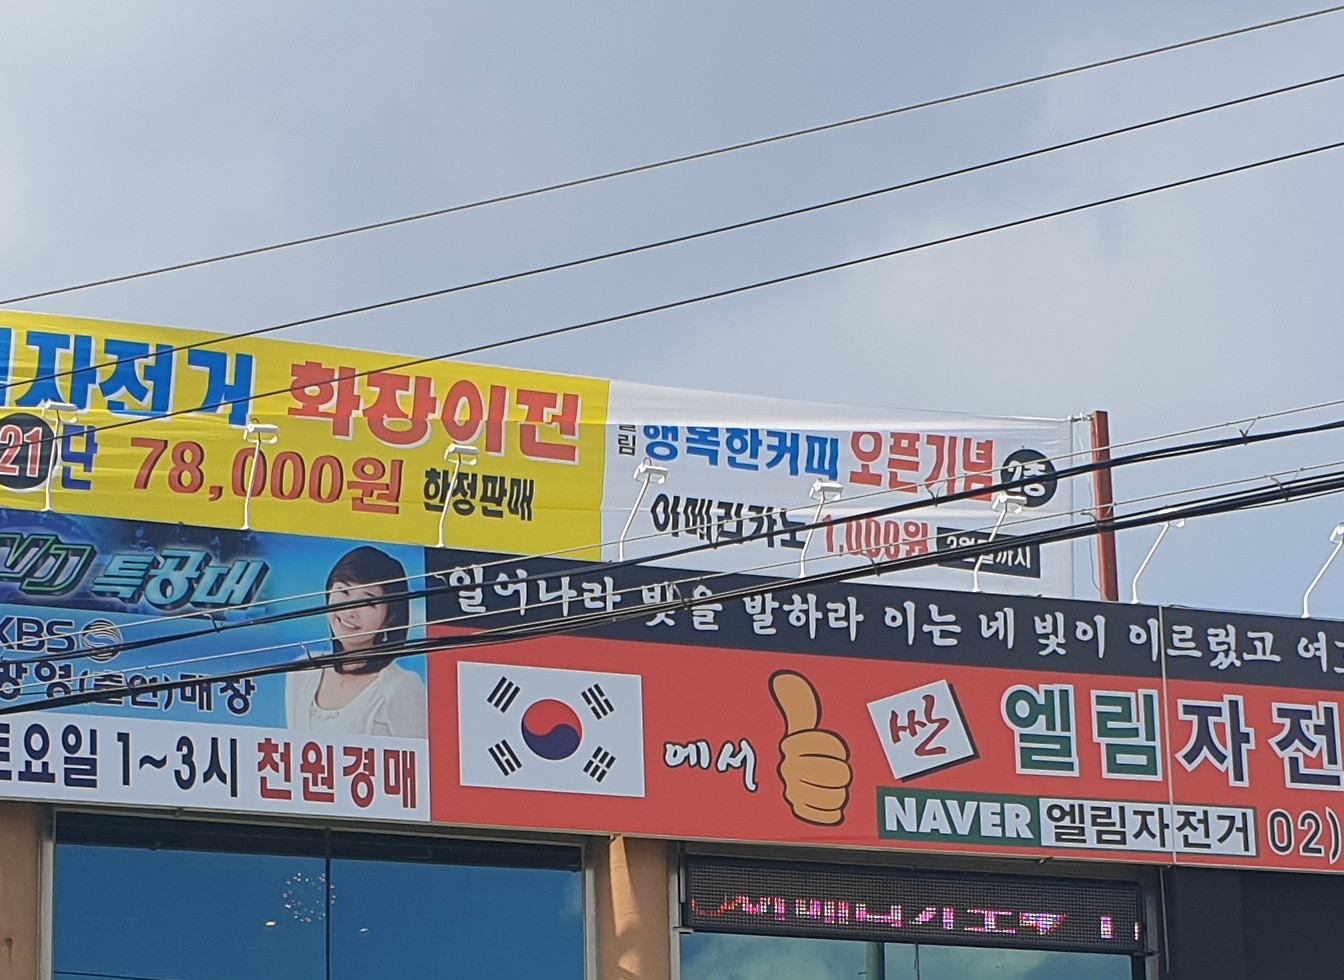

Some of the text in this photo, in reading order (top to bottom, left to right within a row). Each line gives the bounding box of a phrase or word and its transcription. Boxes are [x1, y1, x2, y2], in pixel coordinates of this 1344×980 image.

[288, 360, 584, 464] 화장이전
[618, 425, 636, 456] 림
[130, 436, 404, 516] 78,000원
[423, 469, 536, 522] 한정판매
[643, 425, 840, 482] 행복한커피
[849, 431, 995, 502] 오픈기념
[651, 493, 806, 551] 아메리카노
[91, 547, 272, 608] 특공대
[449, 566, 621, 617] 일어나라
[643, 581, 720, 633] 빛을
[744, 592, 864, 642] 발하라
[884, 602, 963, 648] 이는
[979, 607, 1016, 653] 네
[1034, 612, 1107, 659] 빛이
[116, 731, 239, 798] 1~3시
[257, 738, 417, 809] 천원경매
[663, 738, 759, 794] 에서
[883, 796, 1034, 841] NAVER
[1045, 801, 1254, 854] 엘림자전거
